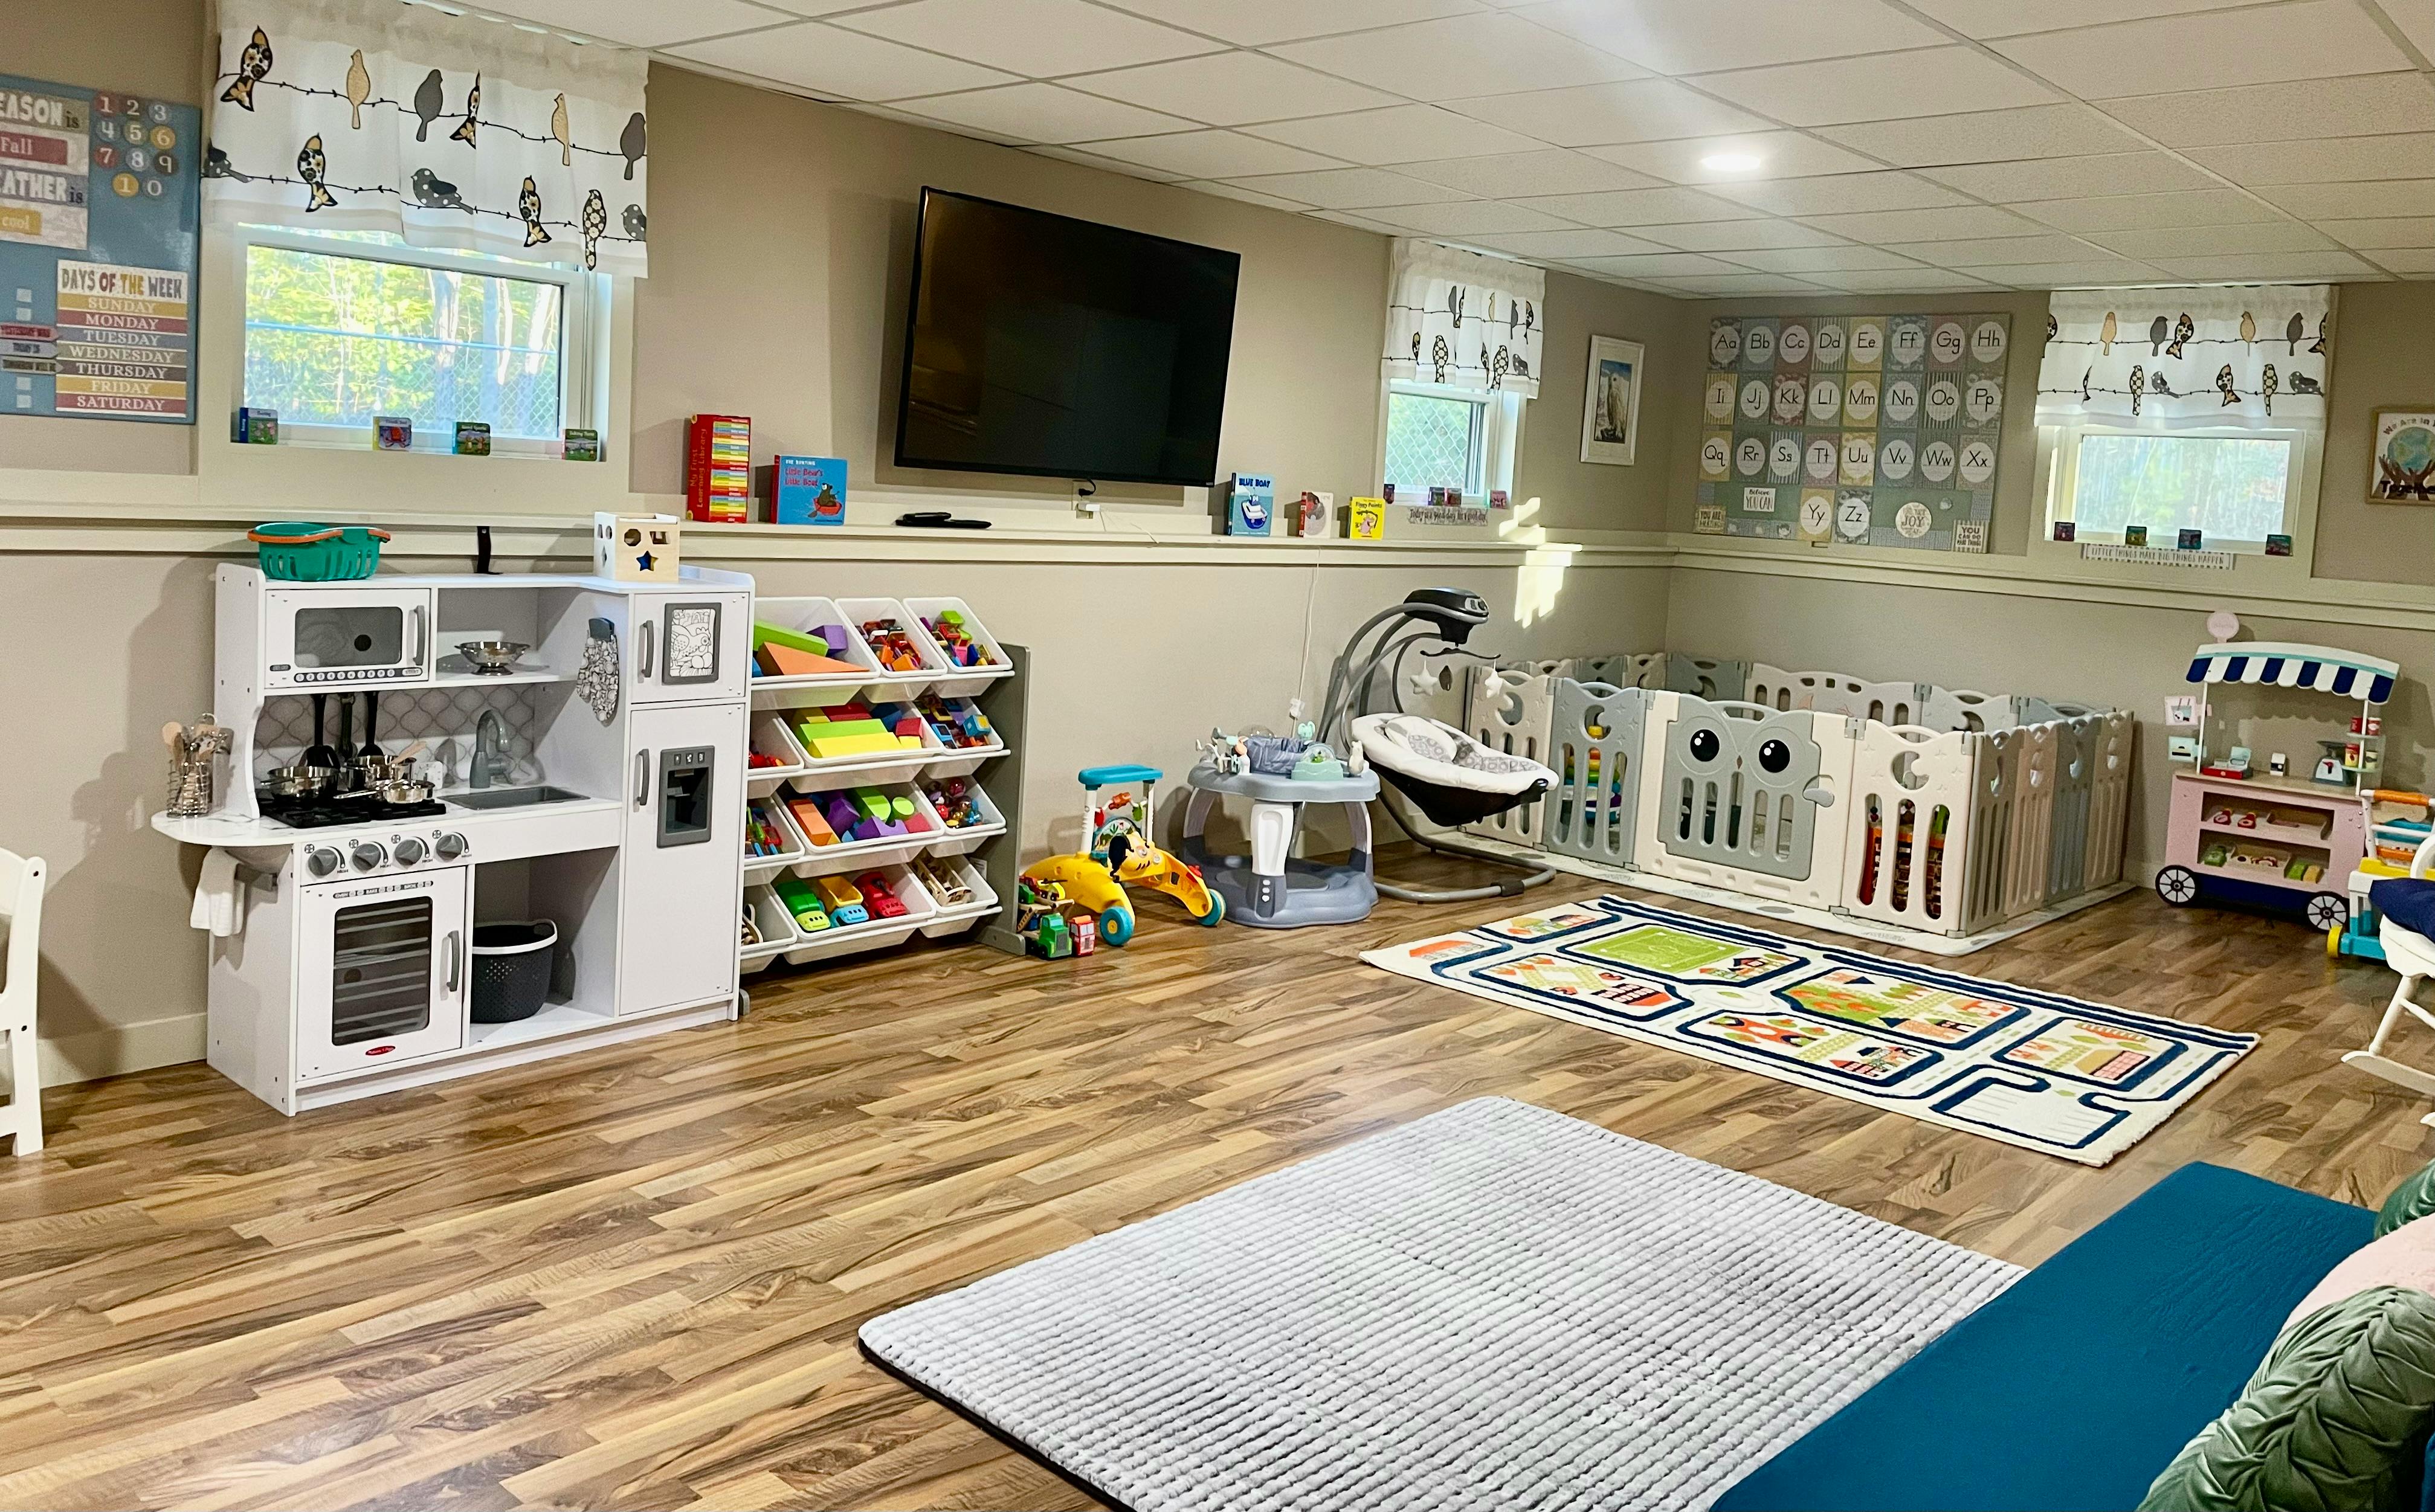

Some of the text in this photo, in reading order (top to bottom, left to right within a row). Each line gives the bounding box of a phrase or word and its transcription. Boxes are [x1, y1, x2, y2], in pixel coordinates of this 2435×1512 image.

[100, 95, 167, 121] 1 2 3
[66, 111, 80, 129] is
[102, 121, 170, 146] 4 5 6
[0, 137, 33, 155] Fall
[100, 147, 172, 173] 7 8 9
[119, 176, 162, 196] 1 0
[69, 186, 83, 204] is
[2, 214, 30, 230] cool
[62, 268, 182, 299] DAYS OF THE WEEK
[88, 297, 156, 314] SUNDAY
[85, 313, 159, 330] MONDAY
[83, 330, 161, 346] TUESDAY
[1715, 334, 1737, 349] Aa
[1750, 333, 1770, 349] Bb
[1785, 333, 1805, 349] Cc
[1819, 332, 1841, 349] Dd
[1857, 332, 1876, 349] Ee
[1900, 331, 1918, 349] Ff
[1937, 331, 1961, 355] Gg
[1978, 330, 2000, 347] Hh
[69, 345, 175, 363] WEDNESDAY
[76, 362, 168, 379] THURSDAY
[91, 380, 152, 394] FRIDAY
[77, 395, 166, 411] SATURDAY
[1716, 388, 1724, 404] Ii
[1747, 388, 1761, 410] Jj
[1780, 388, 1799, 404] Kk
[1818, 389, 1832, 405] Ll
[1849, 388, 1875, 405] Mm
[1892, 389, 1914, 406] Nn
[1932, 389, 1955, 405] Oo
[1975, 388, 1994, 412] Pp
[2383, 423, 2398, 435] We
[2400, 418, 2416, 426] Are
[1704, 445, 1726, 467] Qq
[1743, 446, 1759, 461] Rr
[1778, 446, 1793, 462] Ss
[1813, 448, 1830, 463] Tt
[1848, 447, 1868, 463] Uu
[1889, 448, 1906, 464] Vv
[1926, 449, 1952, 466] Ww
[1966, 450, 1988, 467] Xx
[697, 429, 708, 508] Learning Library
[690, 471, 698, 487] My
[1239, 478, 1271, 488] BLUE BOAT
[1746, 496, 1773, 510] YOU CAN
[1410, 509, 1424, 521] Today
[1808, 503, 1825, 527] Yy
[1845, 506, 1862, 522] Zz
[1901, 515, 1924, 528] JOY
[2091, 547, 2224, 565] LITTLE THINGS MAKE BIG THINGS HAPPEN
